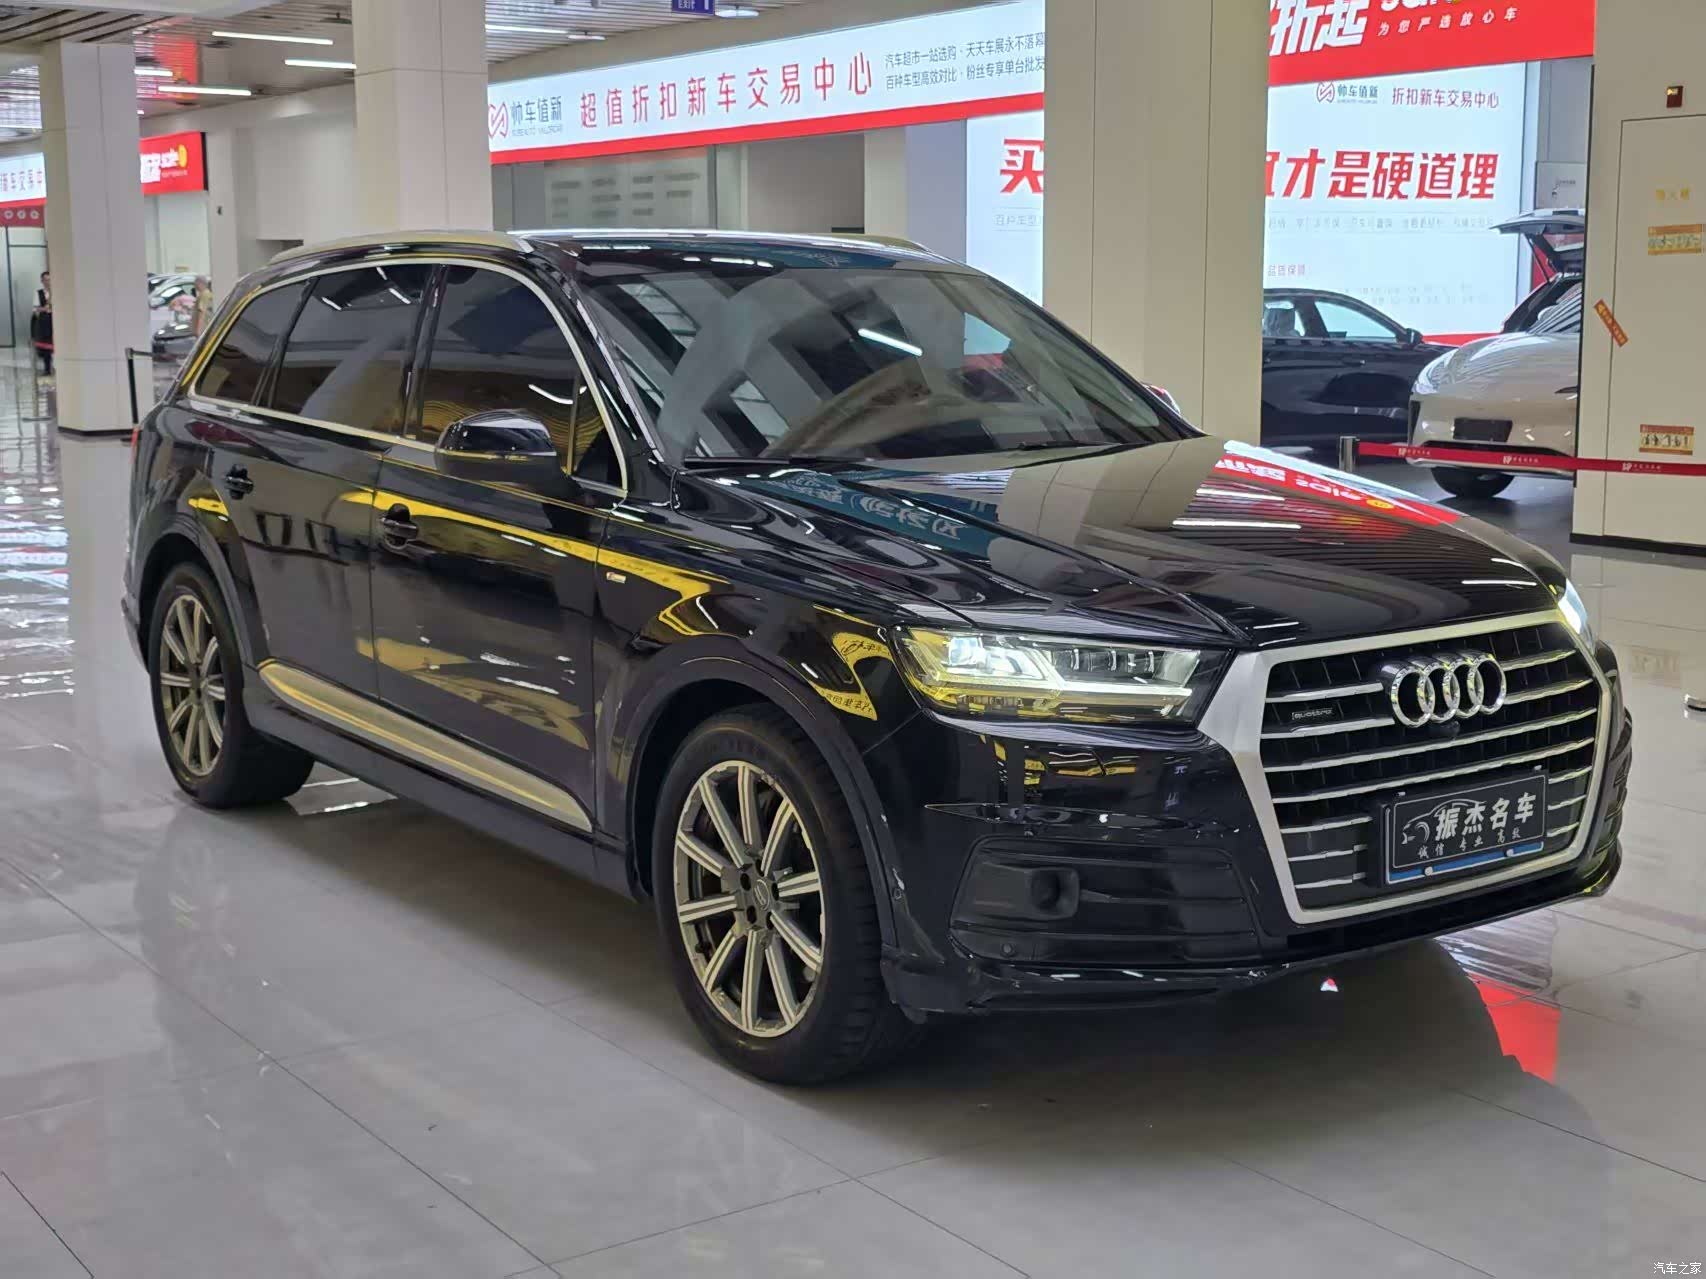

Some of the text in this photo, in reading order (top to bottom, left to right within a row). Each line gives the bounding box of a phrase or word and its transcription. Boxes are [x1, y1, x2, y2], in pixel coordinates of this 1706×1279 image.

[1378, 7, 1517, 36] 为您严选放心车
[580, 52, 872, 128] 超值折扣新车交易中心
[1392, 87, 1499, 108] 折扣新车交易中心
[1000, 138, 1044, 193] 买
[1435, 792, 1536, 842] 振杰名车
